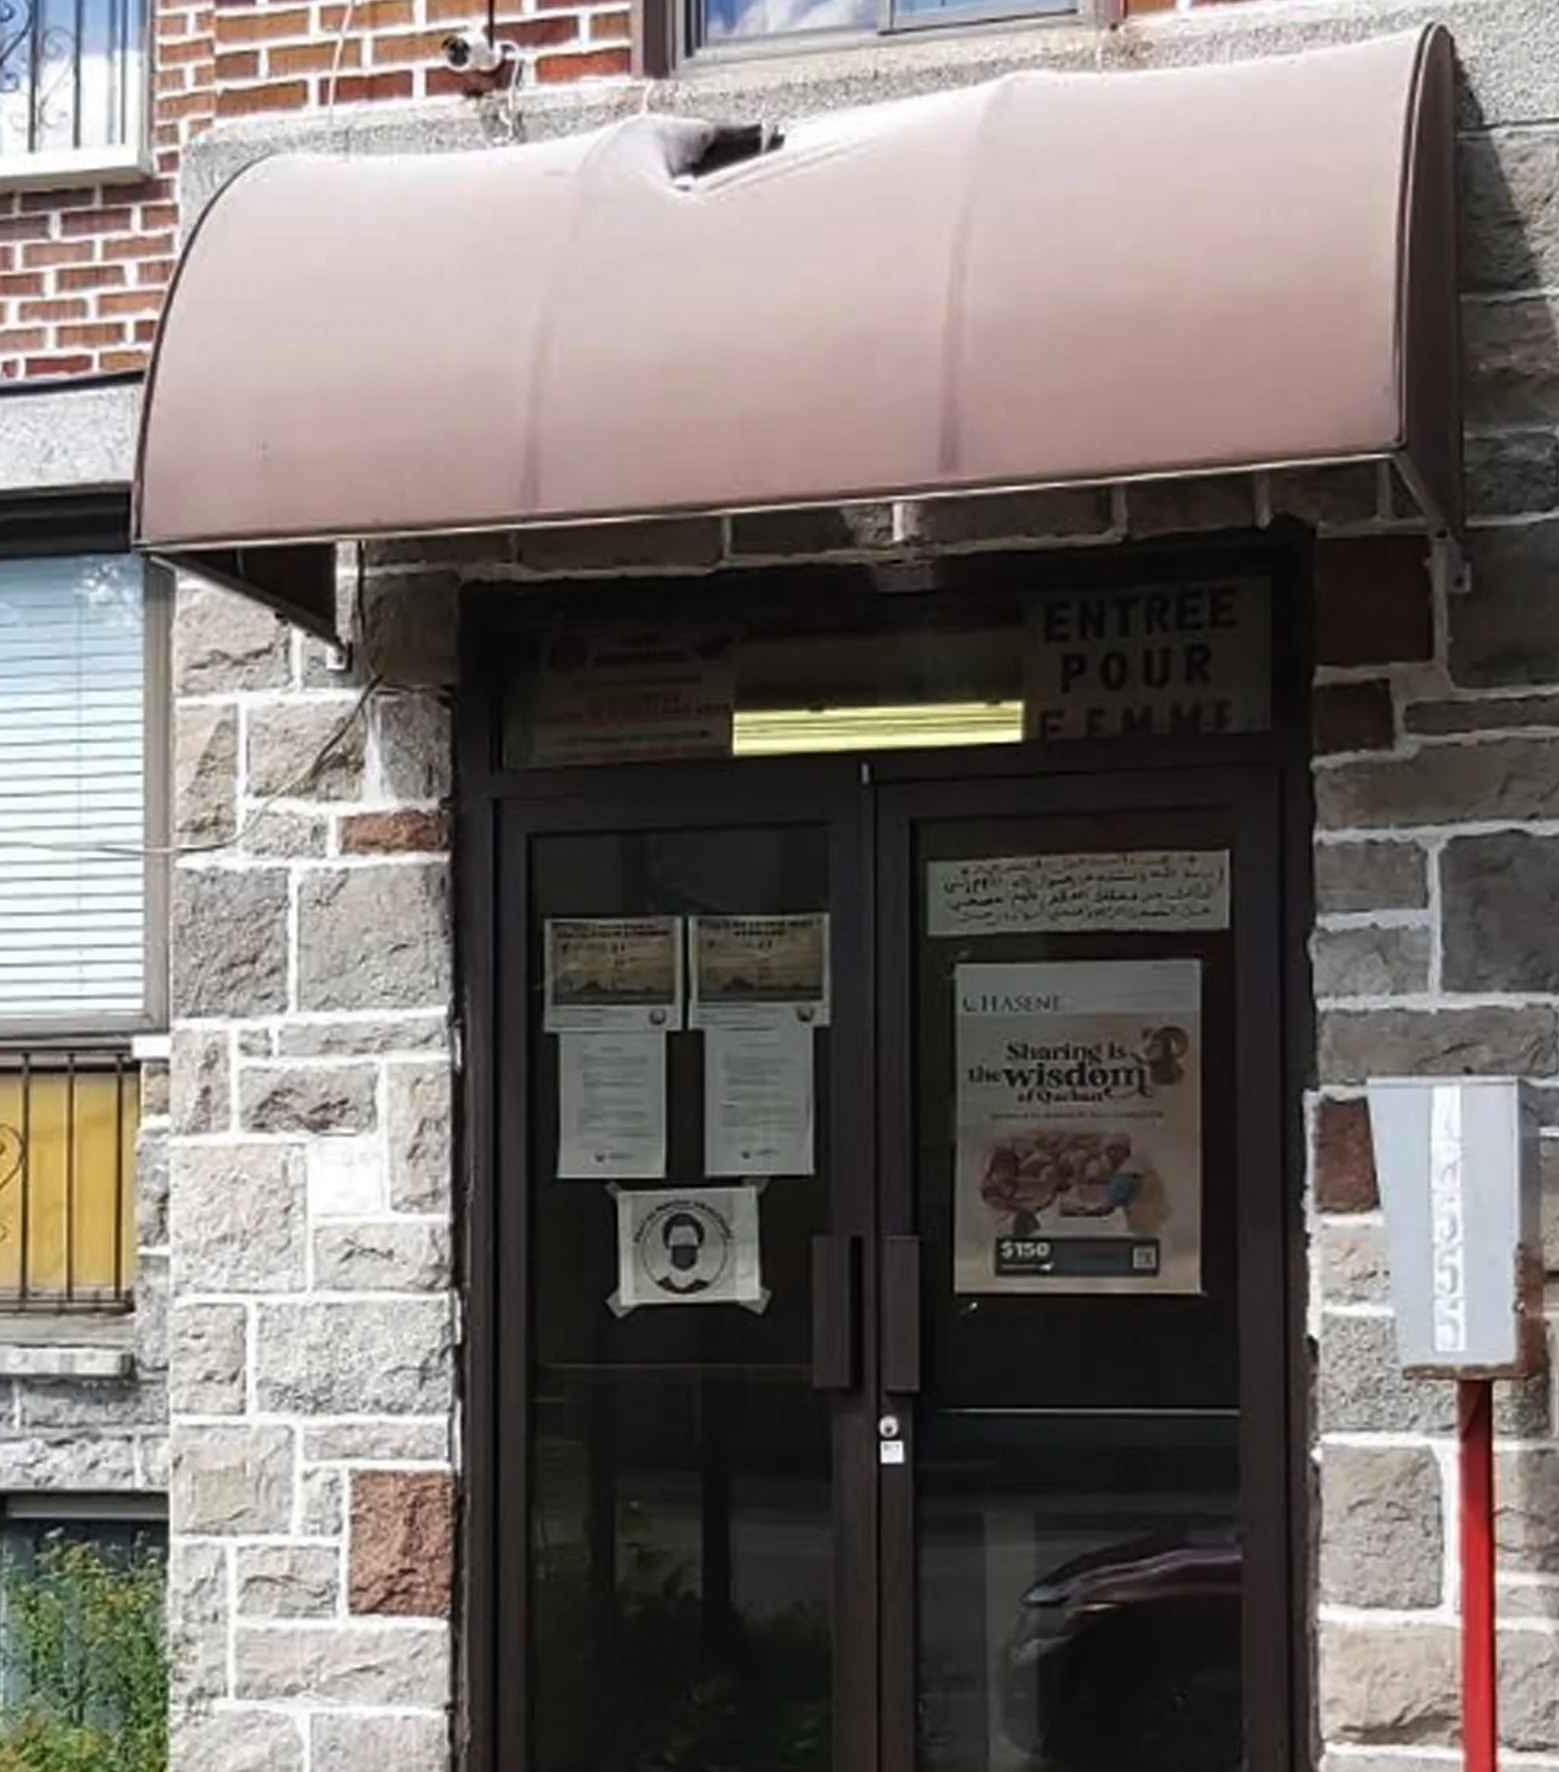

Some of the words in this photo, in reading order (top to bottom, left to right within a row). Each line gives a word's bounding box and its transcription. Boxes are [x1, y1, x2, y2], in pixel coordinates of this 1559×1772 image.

[1043, 585, 1240, 643] ENTREE
[1060, 643, 1212, 694] POUR
[1005, 1041, 1103, 1064] Sharing
[968, 1064, 1001, 1083] the
[1000, 1061, 1154, 1098] wisdom
[1000, 1240, 1051, 1260] $150
